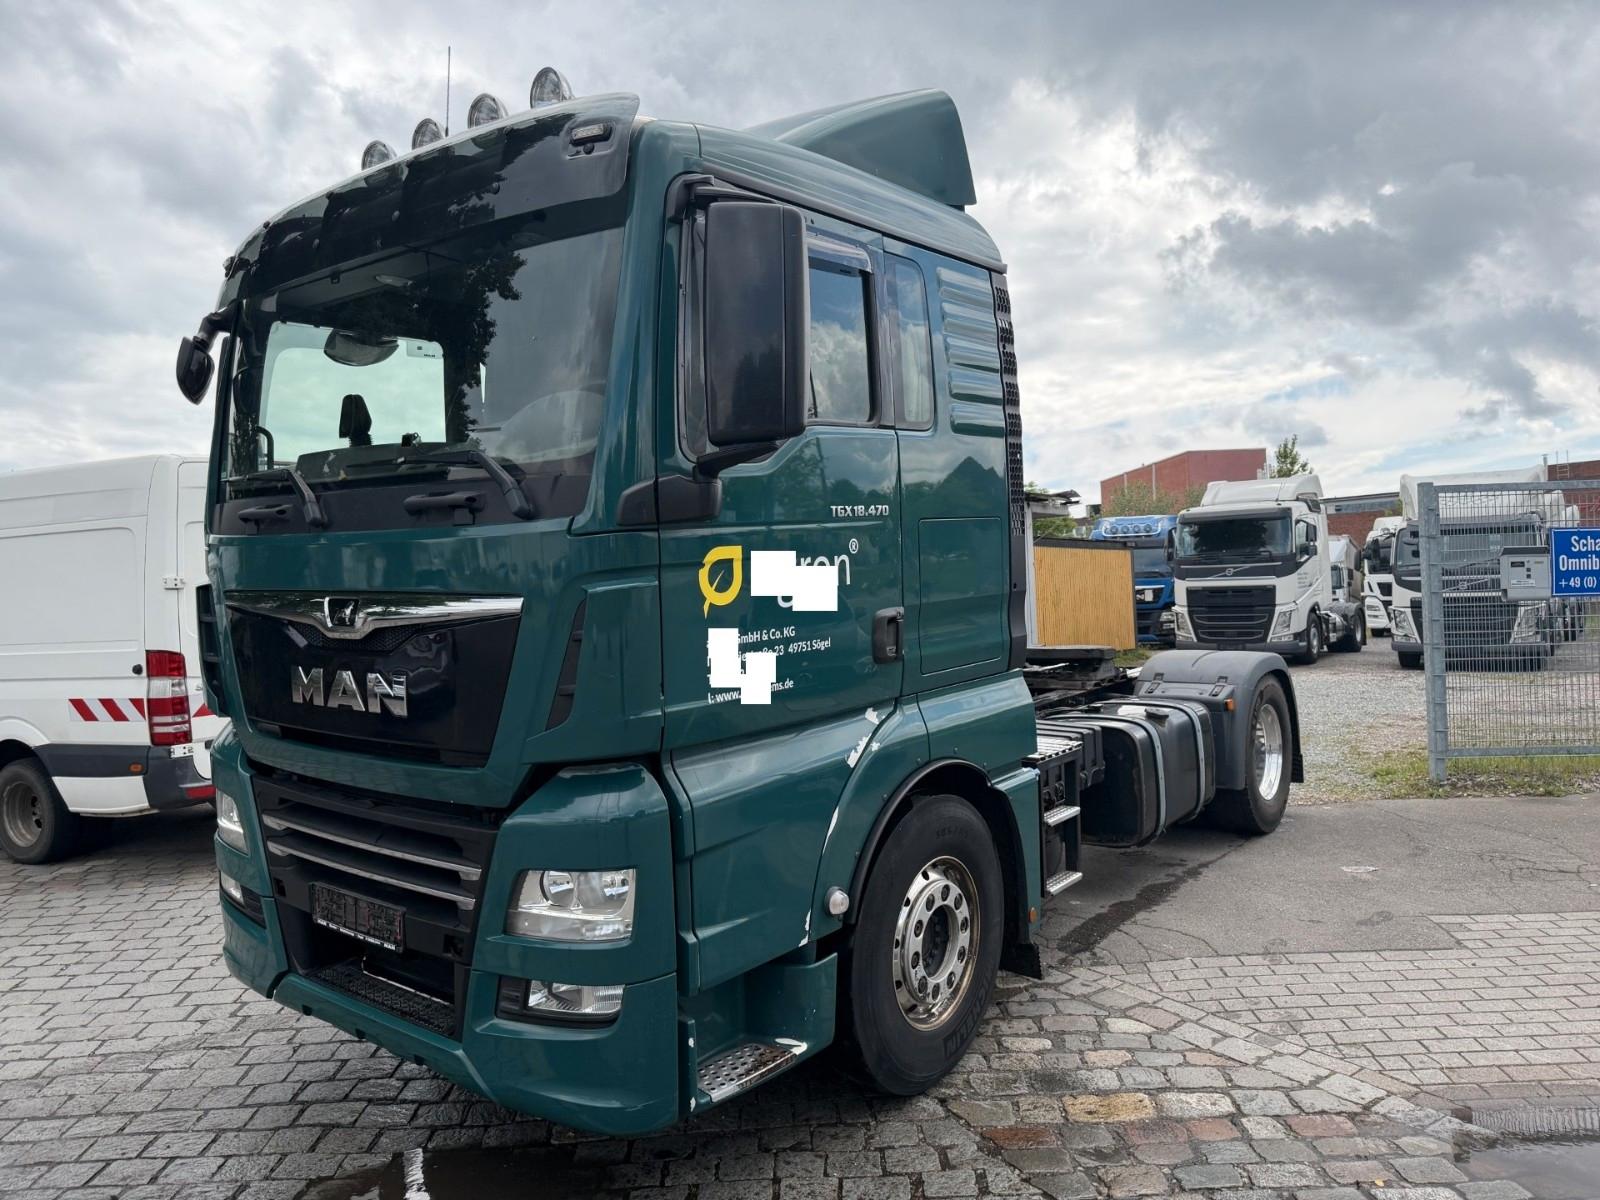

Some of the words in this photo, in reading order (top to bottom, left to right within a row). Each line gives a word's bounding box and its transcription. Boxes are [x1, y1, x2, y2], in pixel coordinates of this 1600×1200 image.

[1570, 535, 1600, 552] Scha
[1559, 554, 1600, 572] Omnib
[1558, 576, 1581, 589] +49
[1583, 576, 1597, 589] (0)
[762, 629, 769, 641] &
[769, 628, 783, 640] Co.
[783, 626, 796, 638] KG
[788, 641, 814, 654] 49751
[812, 637, 831, 651] Sögel
[292, 666, 408, 718] MAN
